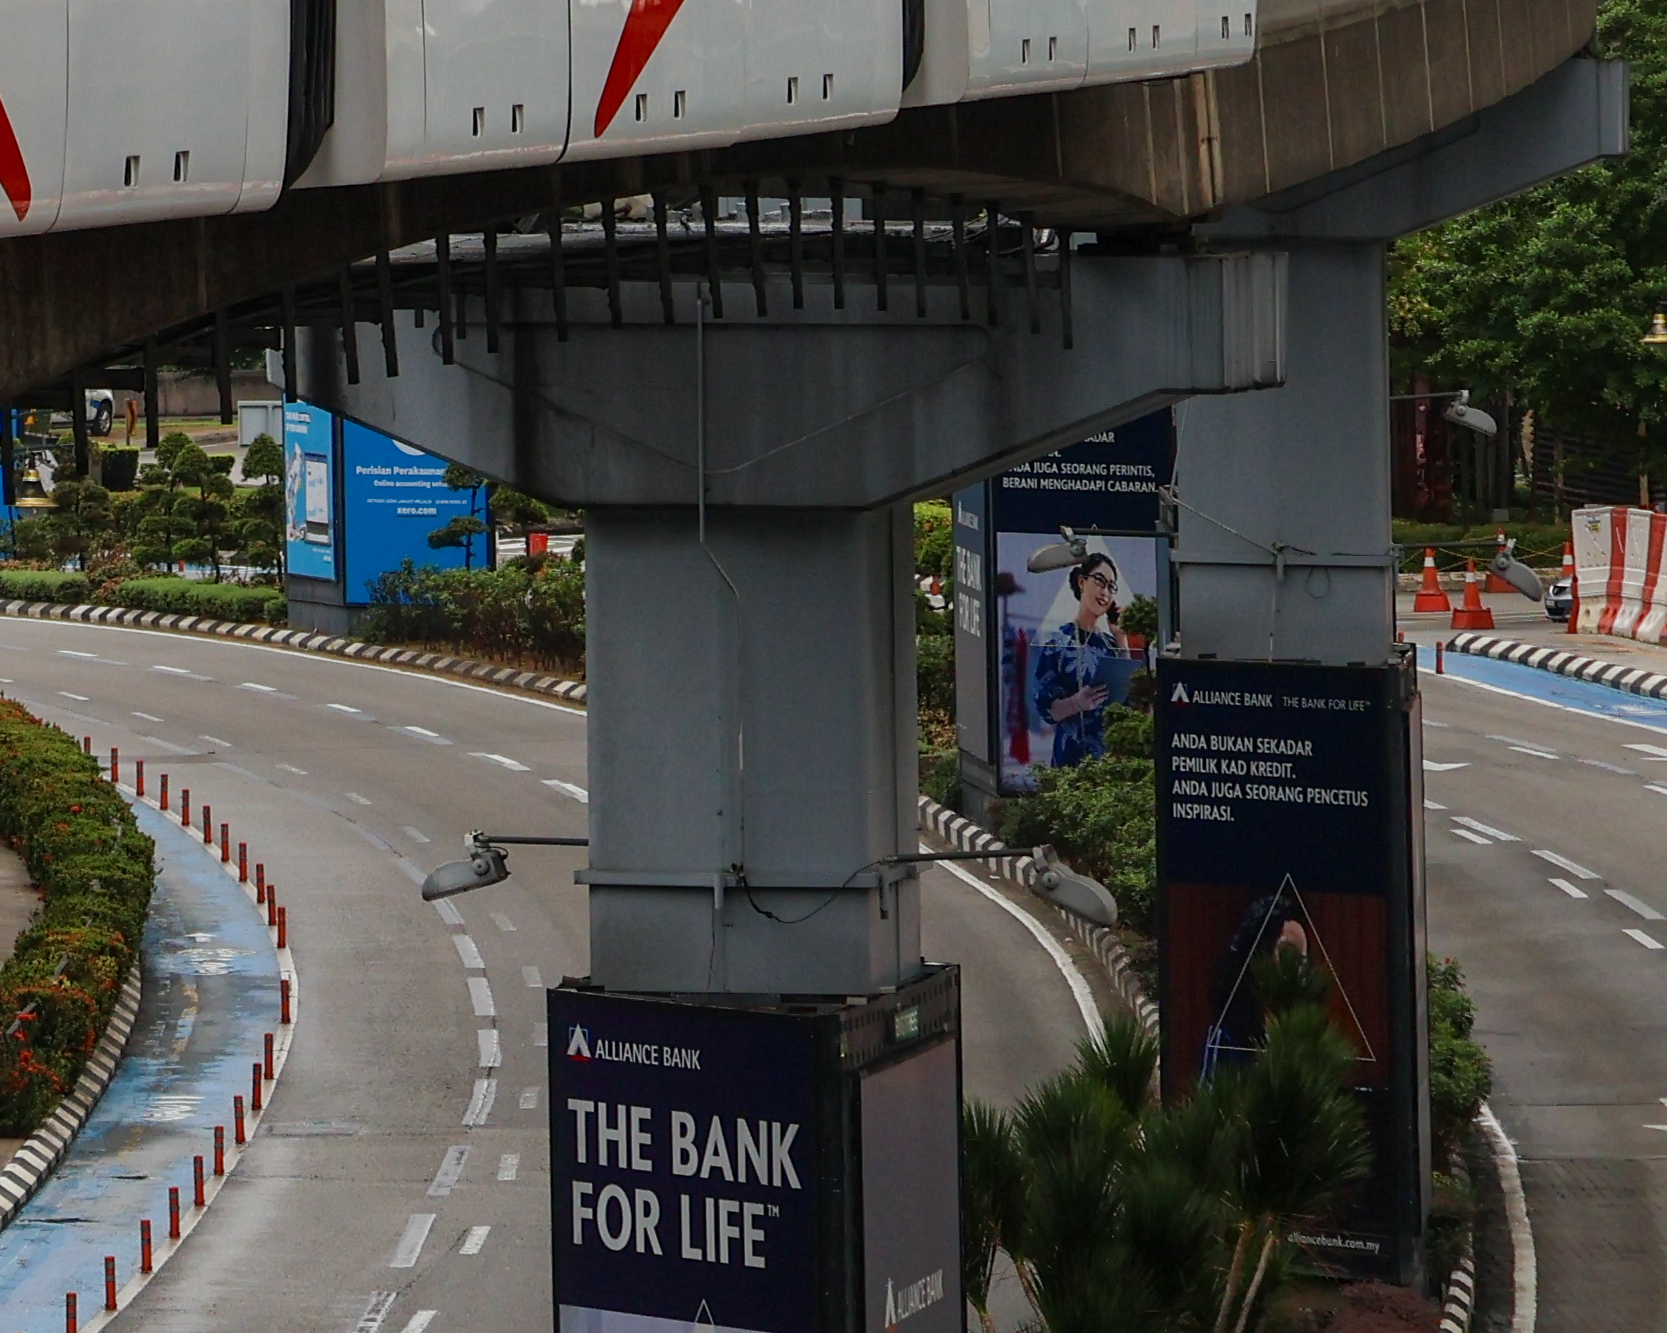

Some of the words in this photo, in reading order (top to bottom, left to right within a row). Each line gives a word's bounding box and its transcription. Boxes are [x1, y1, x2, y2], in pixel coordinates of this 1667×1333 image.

[1007, 461, 1031, 473] NDA
[1033, 462, 1059, 474] JUGA
[1060, 463, 1108, 476] SEORANG
[1109, 464, 1156, 478] PERINTIS,
[1002, 476, 1038, 490] BERANI
[1039, 478, 1106, 492] MENGHADAPI
[1107, 480, 1159, 494] CABARAN.
[1192, 690, 1242, 706] ALLIANCE
[1243, 693, 1273, 708] BANK
[1282, 696, 1299, 708] THE
[1301, 698, 1326, 710] BANK
[1328, 699, 1346, 711] FOR
[1171, 733, 1207, 750] ANDA
[1210, 735, 1254, 753] BUKAN
[1256, 738, 1313, 757] SEKADAR
[1171, 756, 1218, 774] PEMILIK
[1220, 759, 1247, 776] KAD
[1249, 761, 1297, 779] KREDIT.
[1171, 780, 1208, 797] ANDA
[1210, 782, 1242, 800] JUGA
[1245, 784, 1304, 803] SEORANG
[1307, 788, 1369, 807] PENCETUS
[1172, 802, 1235, 821] INSPIRASI.
[594, 1039, 659, 1066] ALLIANCE
[663, 1046, 701, 1070] BANK
[567, 1098, 653, 1172] THE
[670, 1109, 803, 1190] BANK
[572, 1180, 663, 1256] FOR
